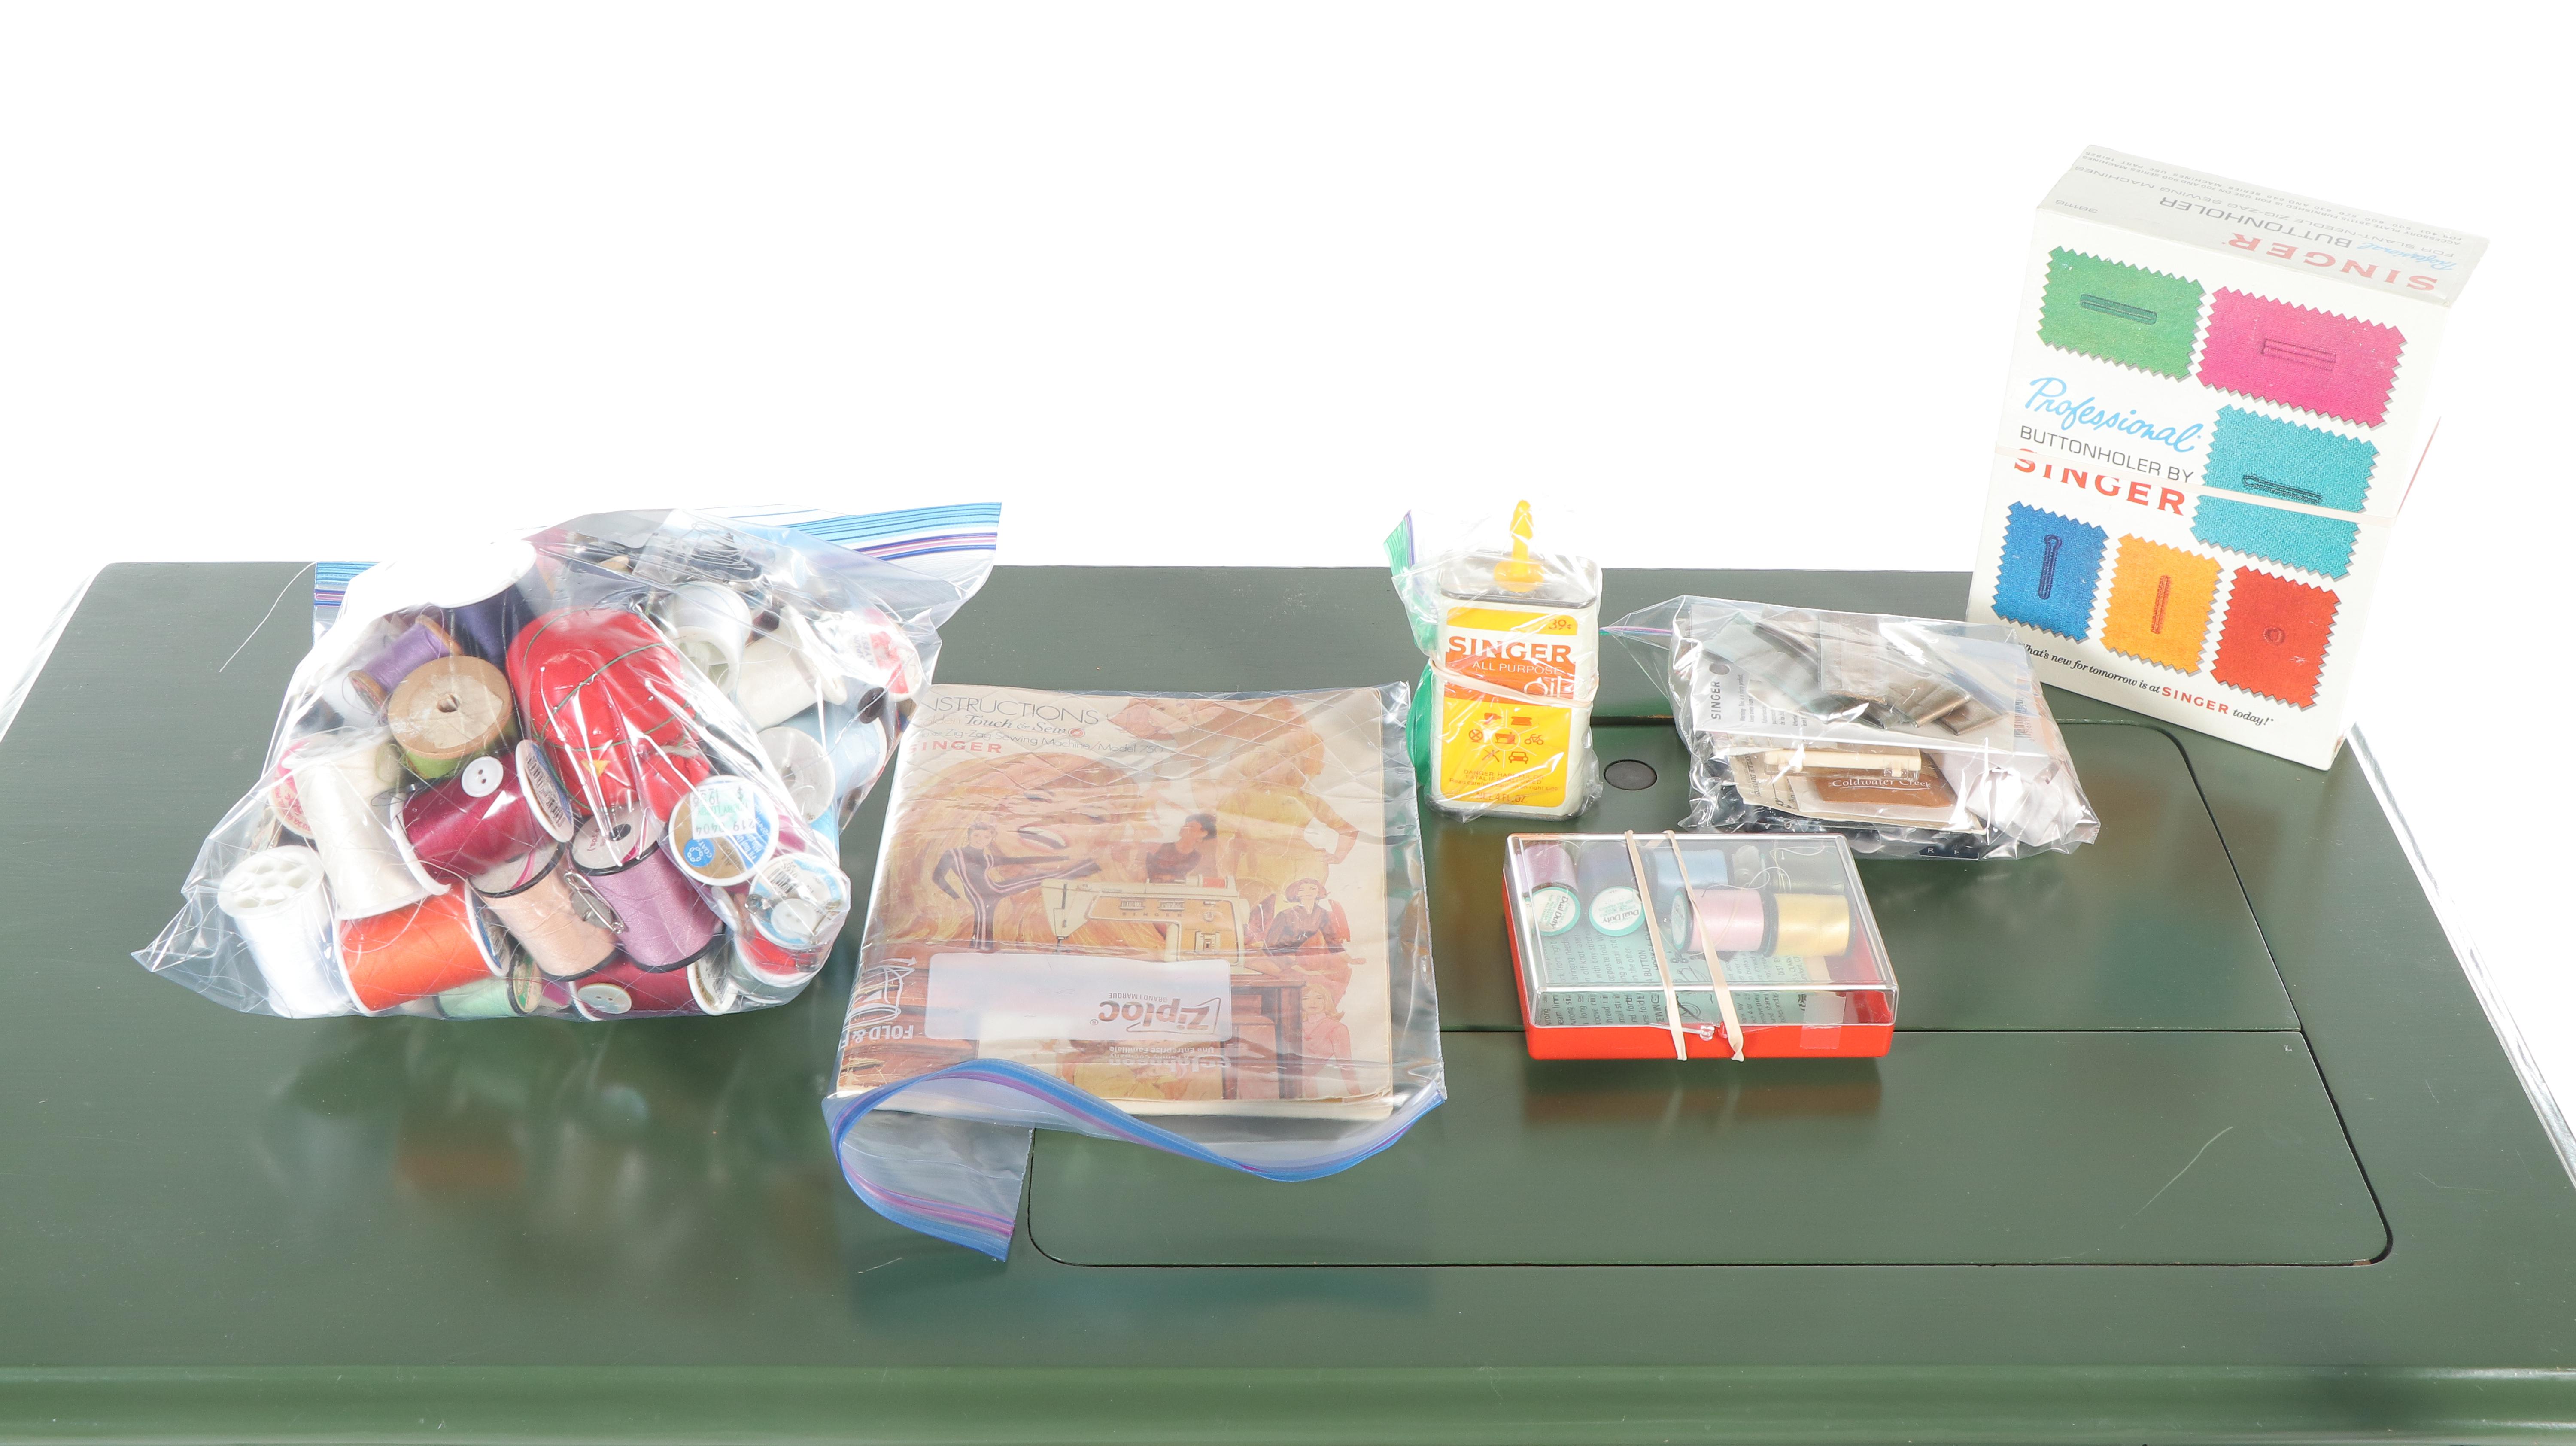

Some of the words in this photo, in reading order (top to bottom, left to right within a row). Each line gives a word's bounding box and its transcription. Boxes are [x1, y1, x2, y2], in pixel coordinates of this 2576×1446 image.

[2073, 165, 2156, 188] MACHINES
[2159, 186, 2222, 204] SEWING
[2226, 202, 2290, 220] ZIG-ZAG
[2157, 195, 2353, 249] BUTTONHOLER
[2293, 217, 2415, 250] SLANT-NEEDLE
[2225, 231, 2439, 293] SINGER
[2355, 238, 2459, 272] Professional
[2420, 246, 2454, 258] FOR
[2024, 377, 2203, 453] Professional
[2020, 425, 2161, 477] BUTTONHOLER
[2168, 460, 2194, 483] BY
[2014, 448, 2186, 516] SINGER
[1447, 635, 1573, 664] SINGER
[1471, 660, 1497, 671] ALL
[1499, 662, 1562, 676] PURPOSE
[2050, 654, 2072, 666] new
[2071, 658, 2089, 673] for
[2088, 665, 2139, 687] tomorrow
[2139, 678, 2148, 690] is
[2148, 682, 2161, 693] at
[2161, 686, 2230, 714] SINGER
[1710, 681, 1721, 720] SINGER
[964, 714, 1012, 729] Touch
[1016, 720, 1030, 730] &
[1032, 720, 1067, 735] Sew
[946, 728, 992, 740] Zig-Zag
[995, 733, 1038, 745] Sewing
[1832, 778, 1895, 788] Coldwater
[1557, 895, 1569, 912] Dual
[1622, 909, 1640, 919] Dual
[1549, 910, 1562, 929] Duty
[1602, 914, 1621, 923] Duty
[1639, 949, 1652, 976] BUTTON
[1143, 994, 1167, 1002] BRAND
[1098, 998, 1209, 1030] Ziploc
[852, 1029, 866, 1043] &
[868, 1024, 914, 1040] FOLD
